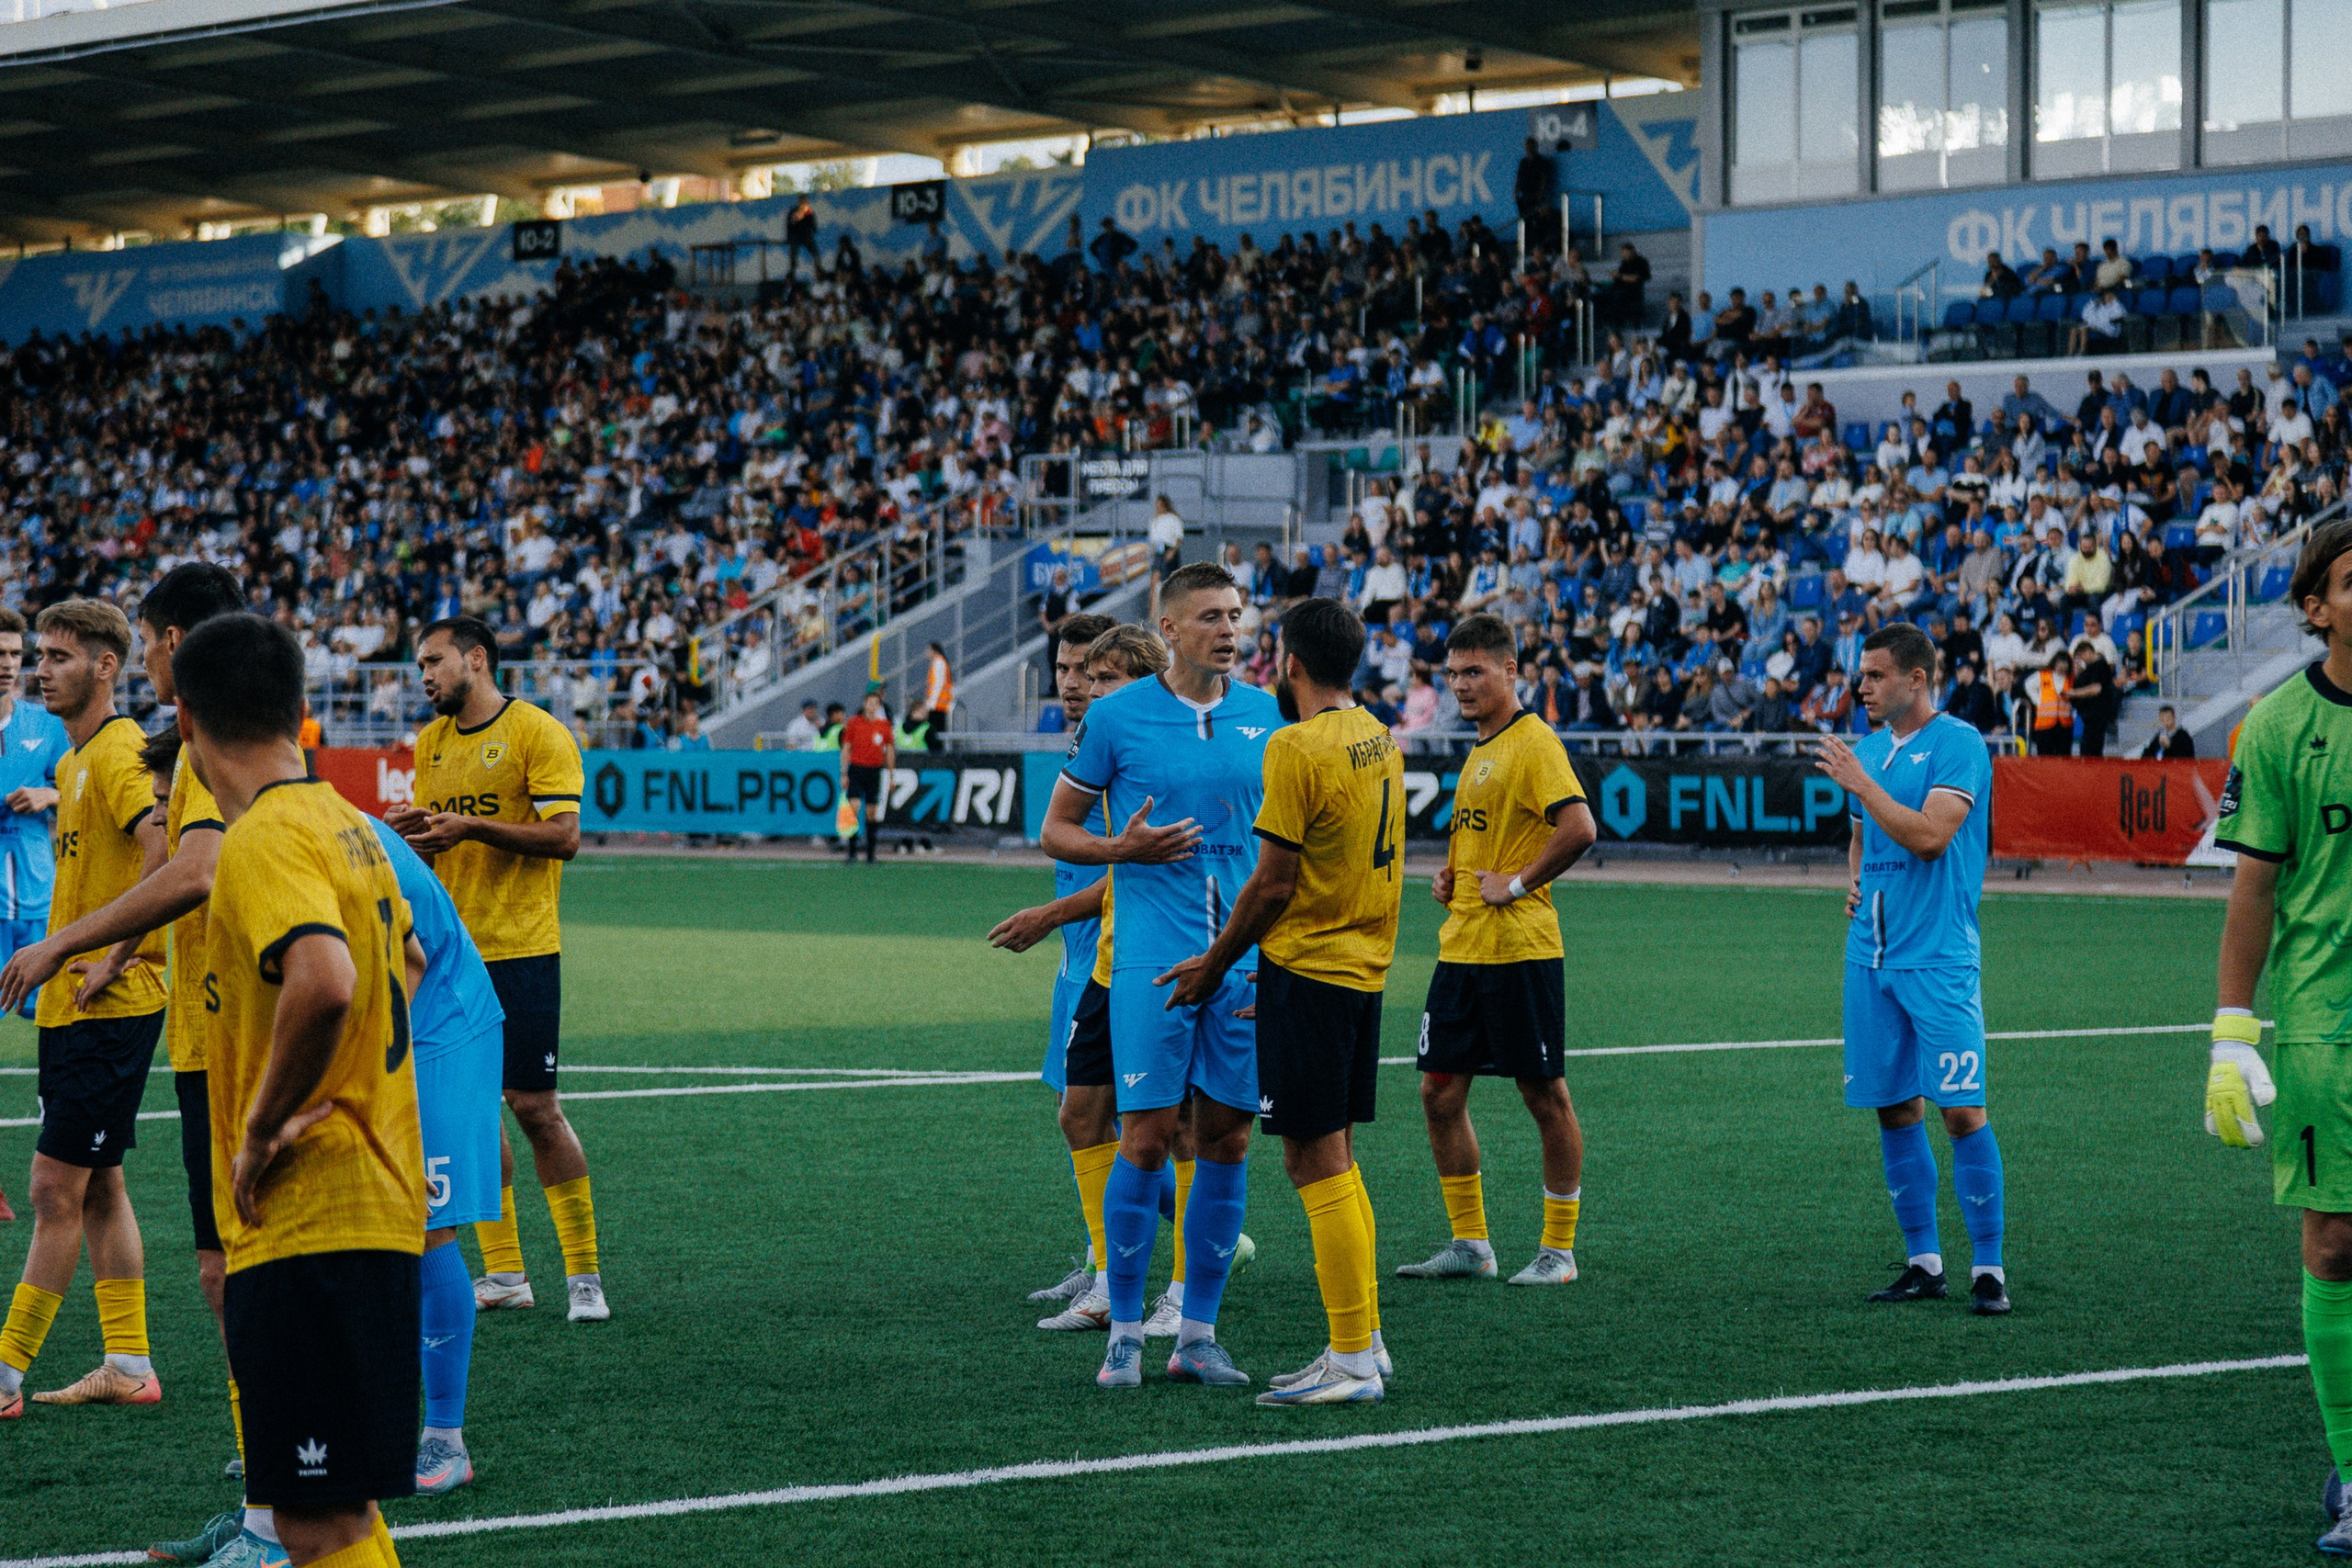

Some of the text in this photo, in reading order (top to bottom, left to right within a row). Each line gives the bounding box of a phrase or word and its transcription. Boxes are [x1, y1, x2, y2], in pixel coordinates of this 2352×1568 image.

[1115, 151, 1493, 231] ФК ЧЕЛЯБИНСК
[1947, 205, 2039, 266] ФК
[643, 769, 835, 814] FNL.PRO
[876, 767, 1017, 824] PARI
[1668, 773, 1851, 833] FNL.P
[2120, 772, 2166, 840] Red
[1184, 843, 1243, 856] ОВАТЭК
[1374, 778, 1396, 883] 4
[1419, 1011, 1430, 1055] 8
[1939, 1050, 1980, 1091] 22
[427, 1156, 451, 1207] 5
[2300, 1125, 2316, 1186] 1
